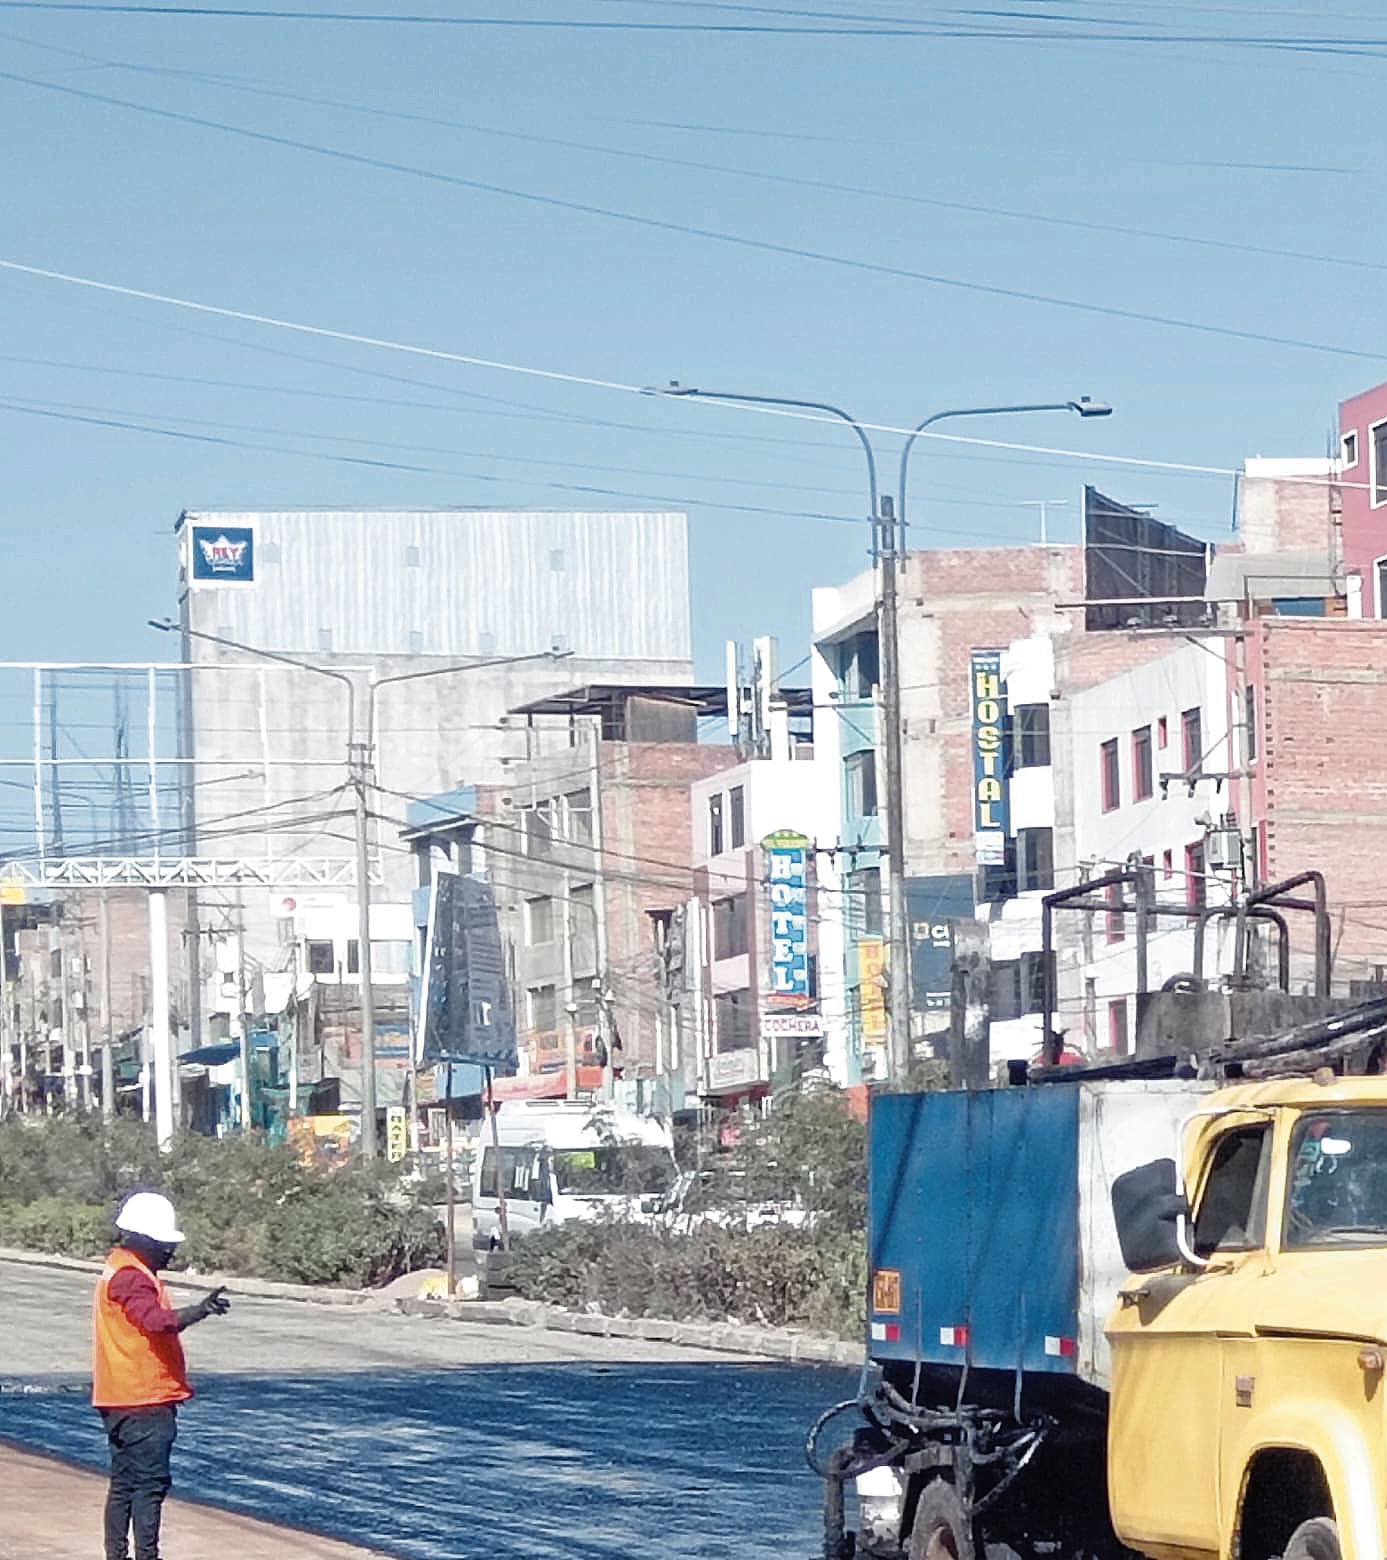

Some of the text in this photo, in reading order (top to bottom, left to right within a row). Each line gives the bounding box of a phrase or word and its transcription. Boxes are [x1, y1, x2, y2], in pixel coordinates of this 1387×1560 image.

[975, 672, 1001, 828] HOSTAL
[771, 855, 794, 991] HOTEL
[764, 1018, 821, 1033] COCHERA
